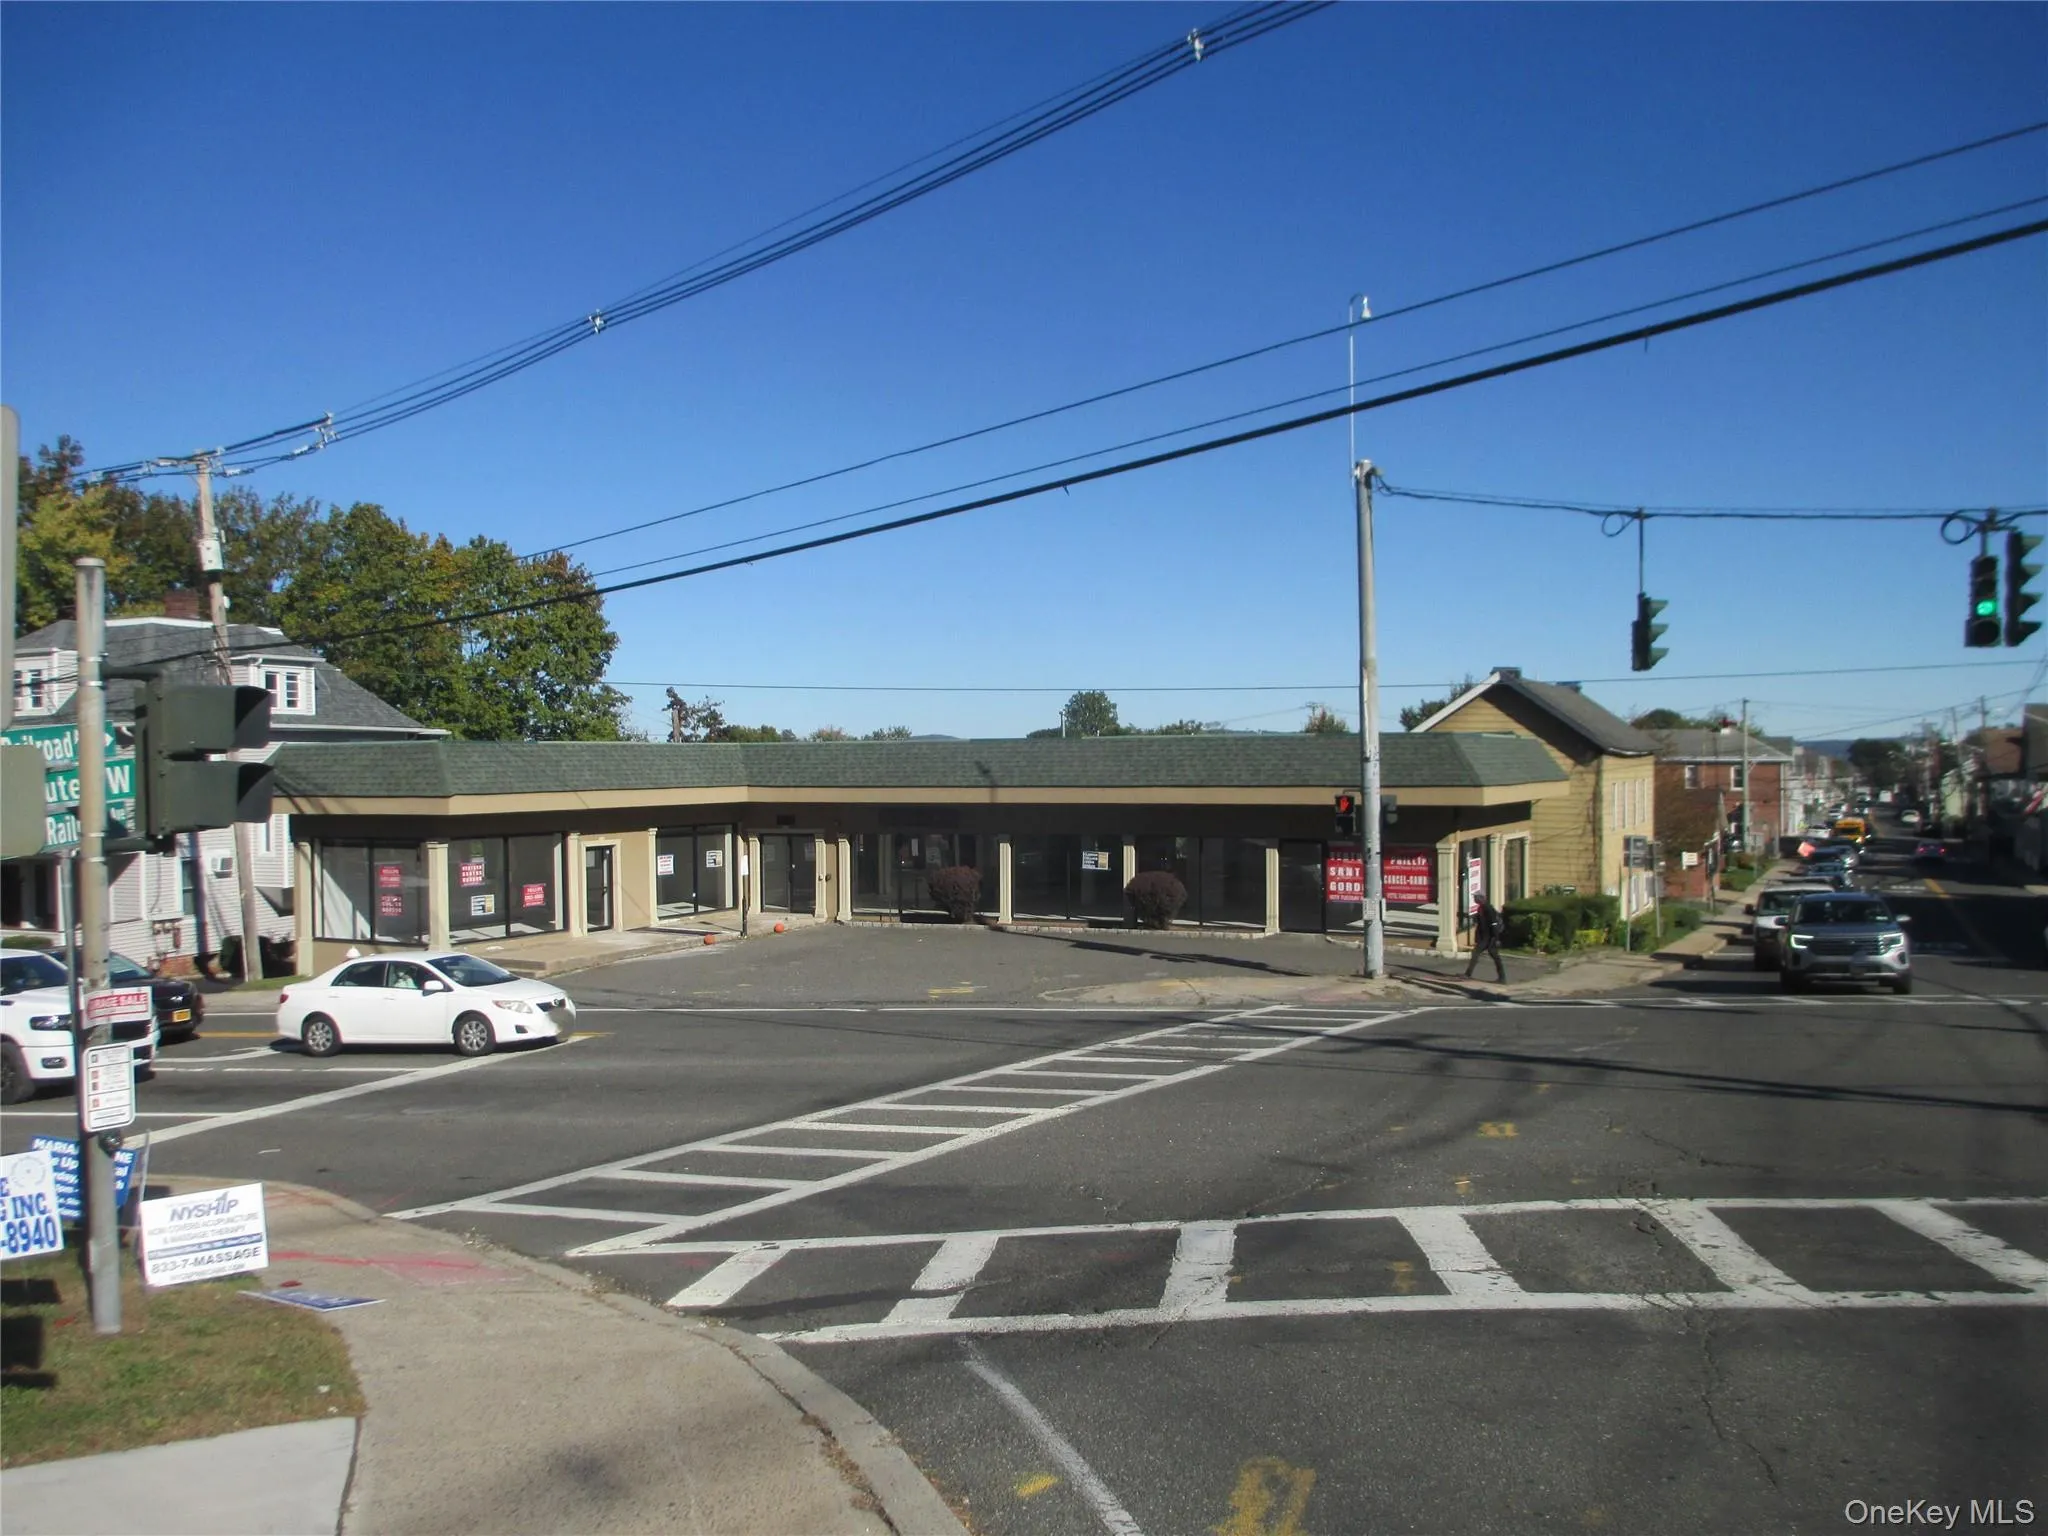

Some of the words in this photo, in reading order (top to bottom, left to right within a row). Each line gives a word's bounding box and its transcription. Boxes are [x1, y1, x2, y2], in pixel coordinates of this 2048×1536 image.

[45, 775, 80, 802] ute
[46, 815, 81, 846] Rail
[1329, 867, 1361, 876] SANT
[1329, 882, 1364, 892] GORD
[169, 1191, 239, 1222] NYSHIP
[151, 1246, 262, 1274] 833-7-MASSAGE
